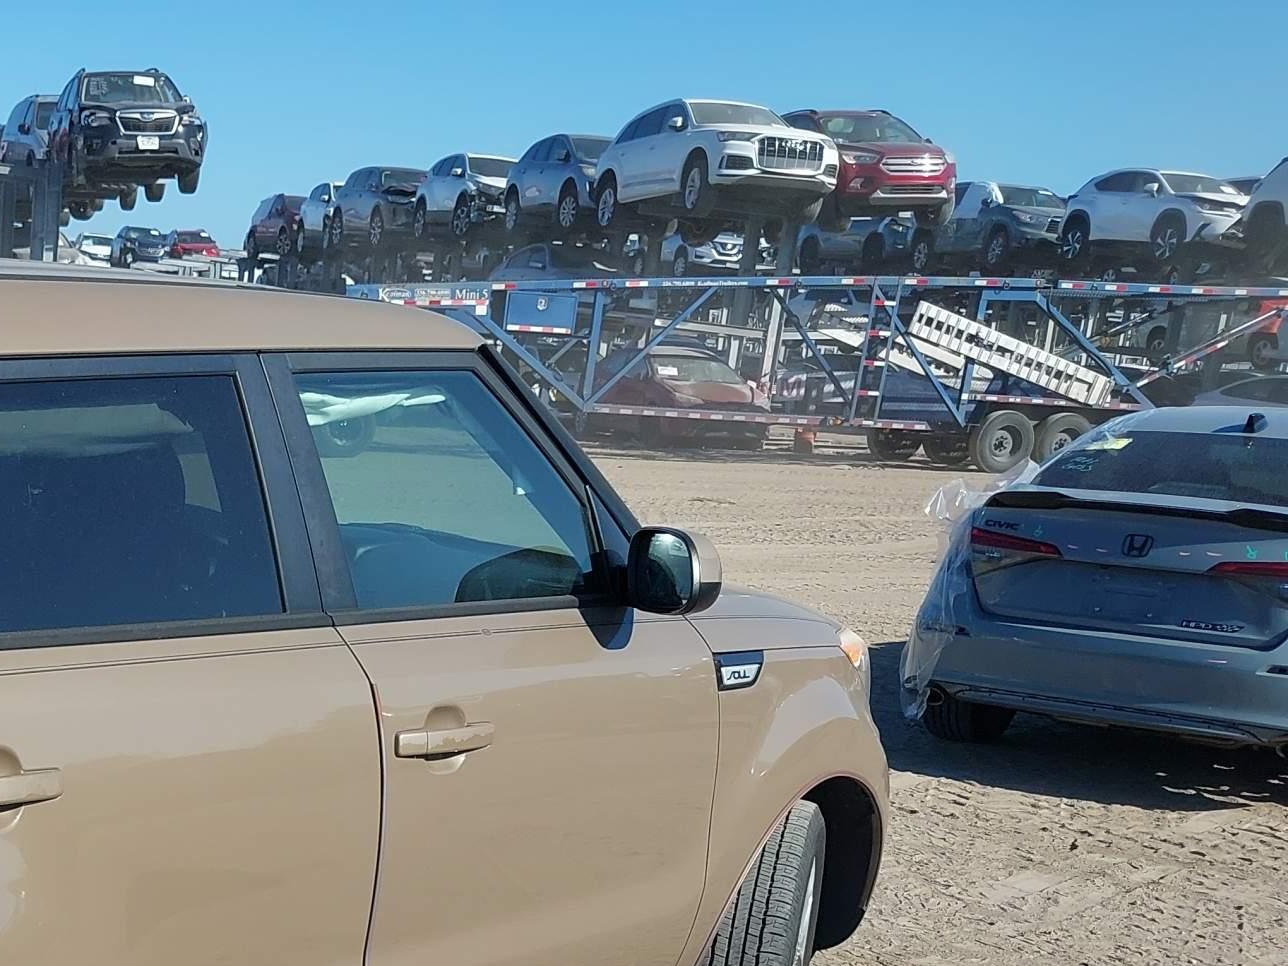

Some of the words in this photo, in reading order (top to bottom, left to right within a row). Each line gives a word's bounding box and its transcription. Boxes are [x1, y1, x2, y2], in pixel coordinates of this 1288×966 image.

[455, 288, 480, 300] Mini
[481, 288, 489, 300] 5
[984, 519, 1020, 531] CIVIC
